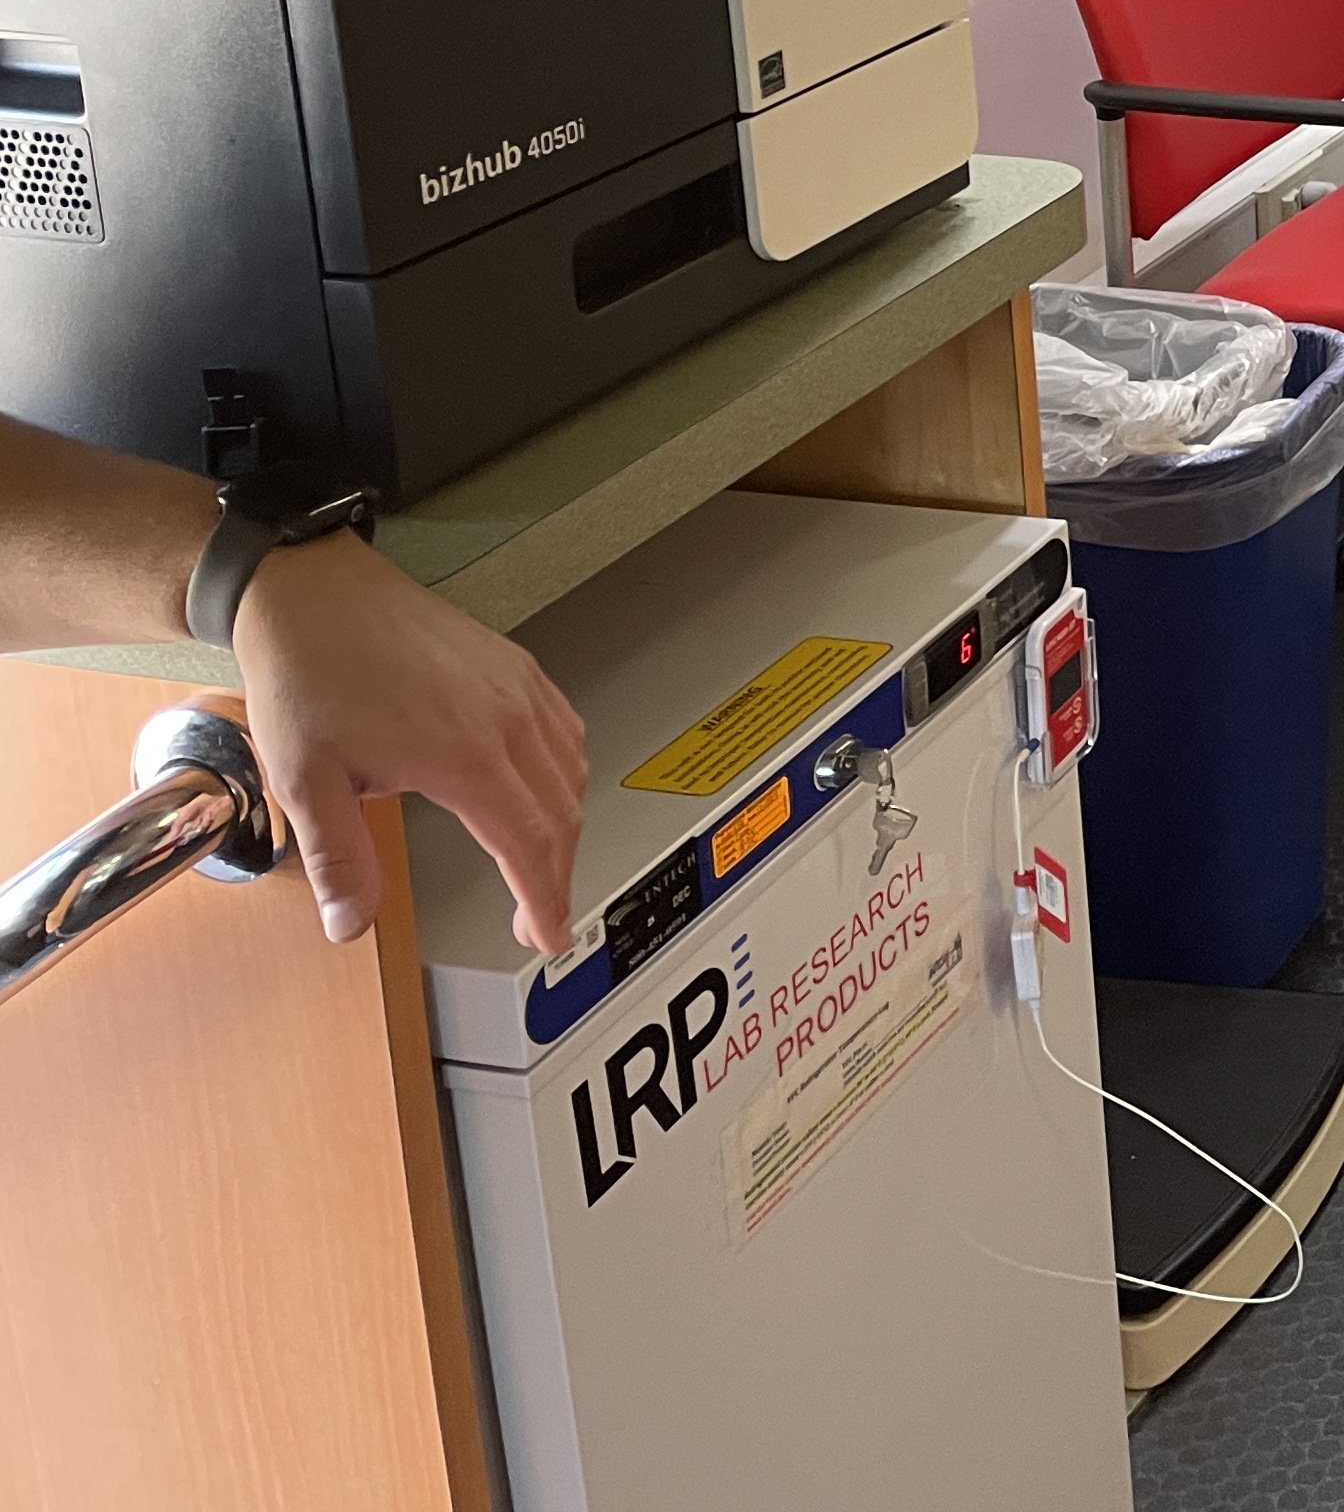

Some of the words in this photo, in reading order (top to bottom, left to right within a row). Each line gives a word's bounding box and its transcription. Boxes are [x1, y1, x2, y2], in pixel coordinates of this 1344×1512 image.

[419, 139, 522, 205] bizhub
[527, 117, 585, 159] 4050i
[961, 633, 972, 664] 6
[703, 1012, 762, 1093] LAB
[770, 851, 924, 1028] RESEARCH
[776, 901, 930, 1078] PRODUCTS
[570, 967, 729, 1209] LRP
